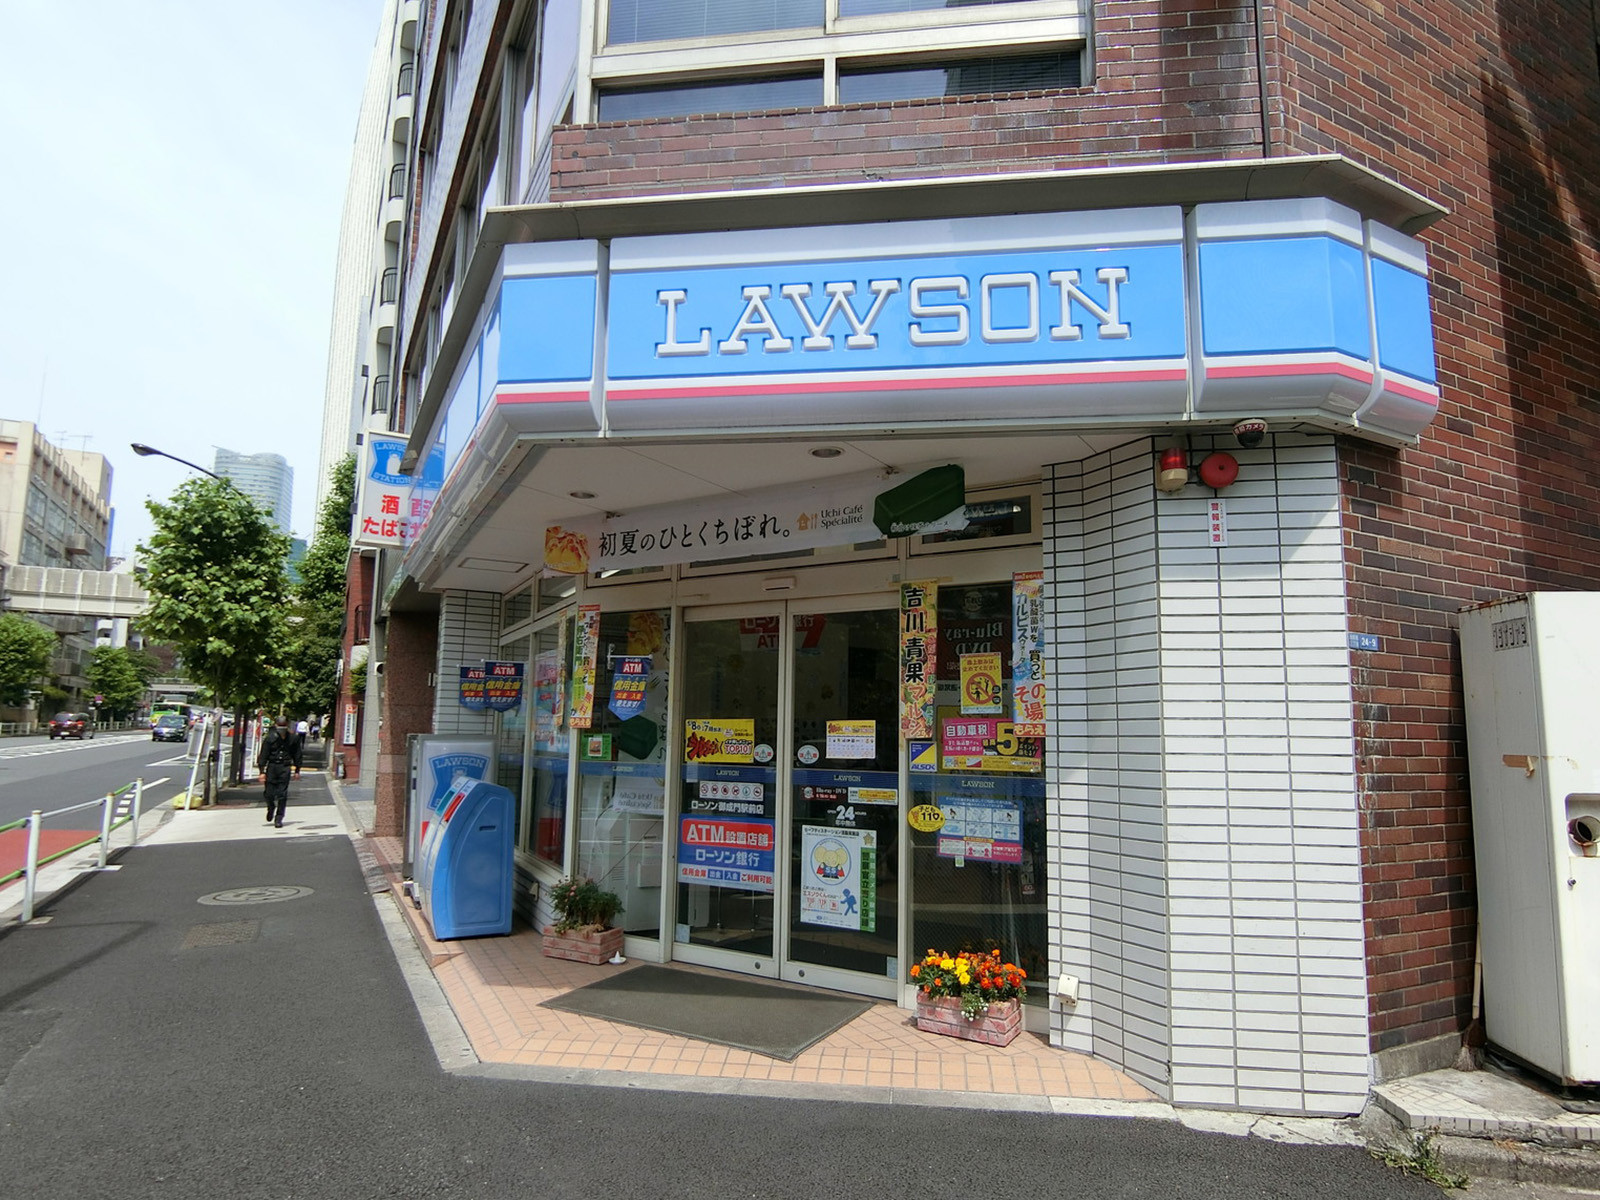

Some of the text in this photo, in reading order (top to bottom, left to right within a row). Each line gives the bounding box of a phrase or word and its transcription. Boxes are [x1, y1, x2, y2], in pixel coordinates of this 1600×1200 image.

[655, 266, 1131, 357] LAWSON
[373, 472, 411, 484] STATION
[381, 494, 400, 515] 酒
[821, 504, 863, 519] Uchi Café
[362, 516, 407, 538] たばこ
[821, 514, 863, 529] Spécialité
[598, 513, 790, 558] 初夏のひとくちぼれ。
[904, 587, 925, 684] 吉川青果
[1361, 636, 1376, 647] 24-9
[494, 667, 515, 675] ATM
[623, 663, 643, 673] ATM
[613, 680, 647, 692] 信用金庫
[946, 723, 988, 737] 自動車税
[435, 757, 485, 769] LAWSON
[961, 780, 995, 788] LAWSON
[836, 805, 855, 820] 24
[696, 848, 760, 867] ローソン銀行
